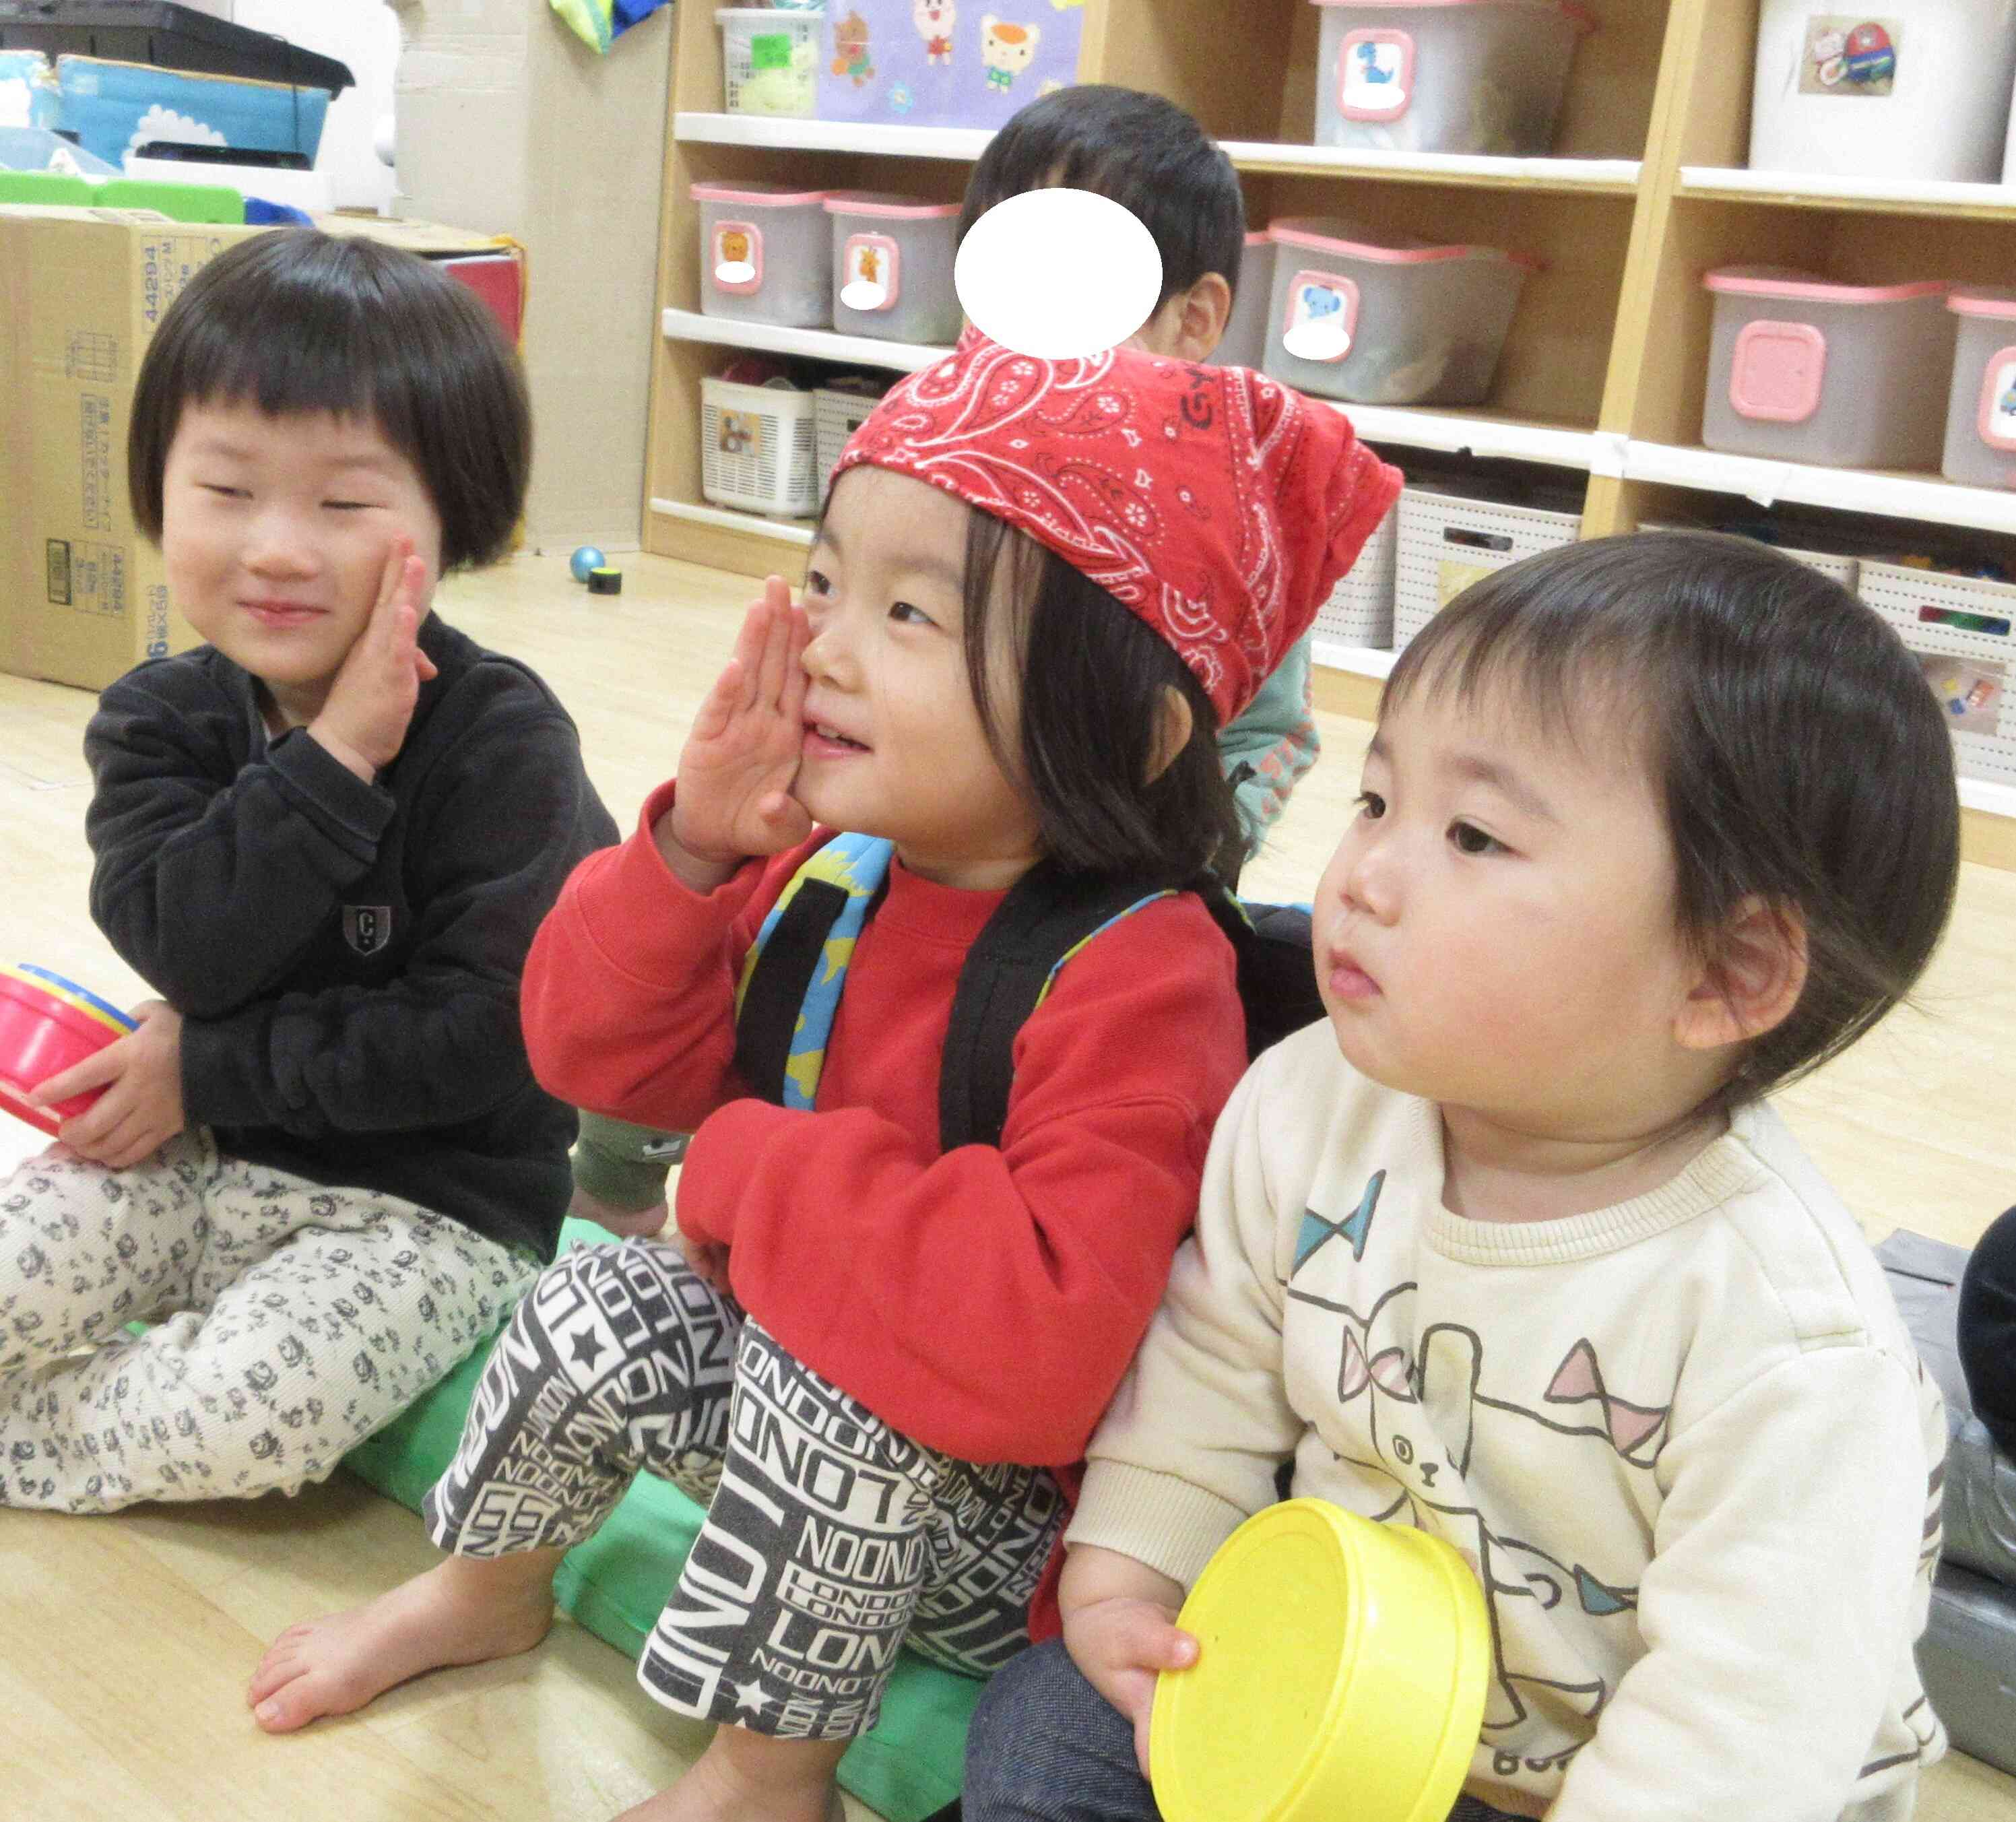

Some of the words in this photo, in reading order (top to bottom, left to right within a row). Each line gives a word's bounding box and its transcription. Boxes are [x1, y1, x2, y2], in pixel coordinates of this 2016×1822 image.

[145, 246, 158, 321] 44294
[359, 913, 373, 936] C
[794, 1515, 928, 1582] ONDON
[789, 1569, 909, 1613] LONDO
[767, 1608, 897, 1672] LON
